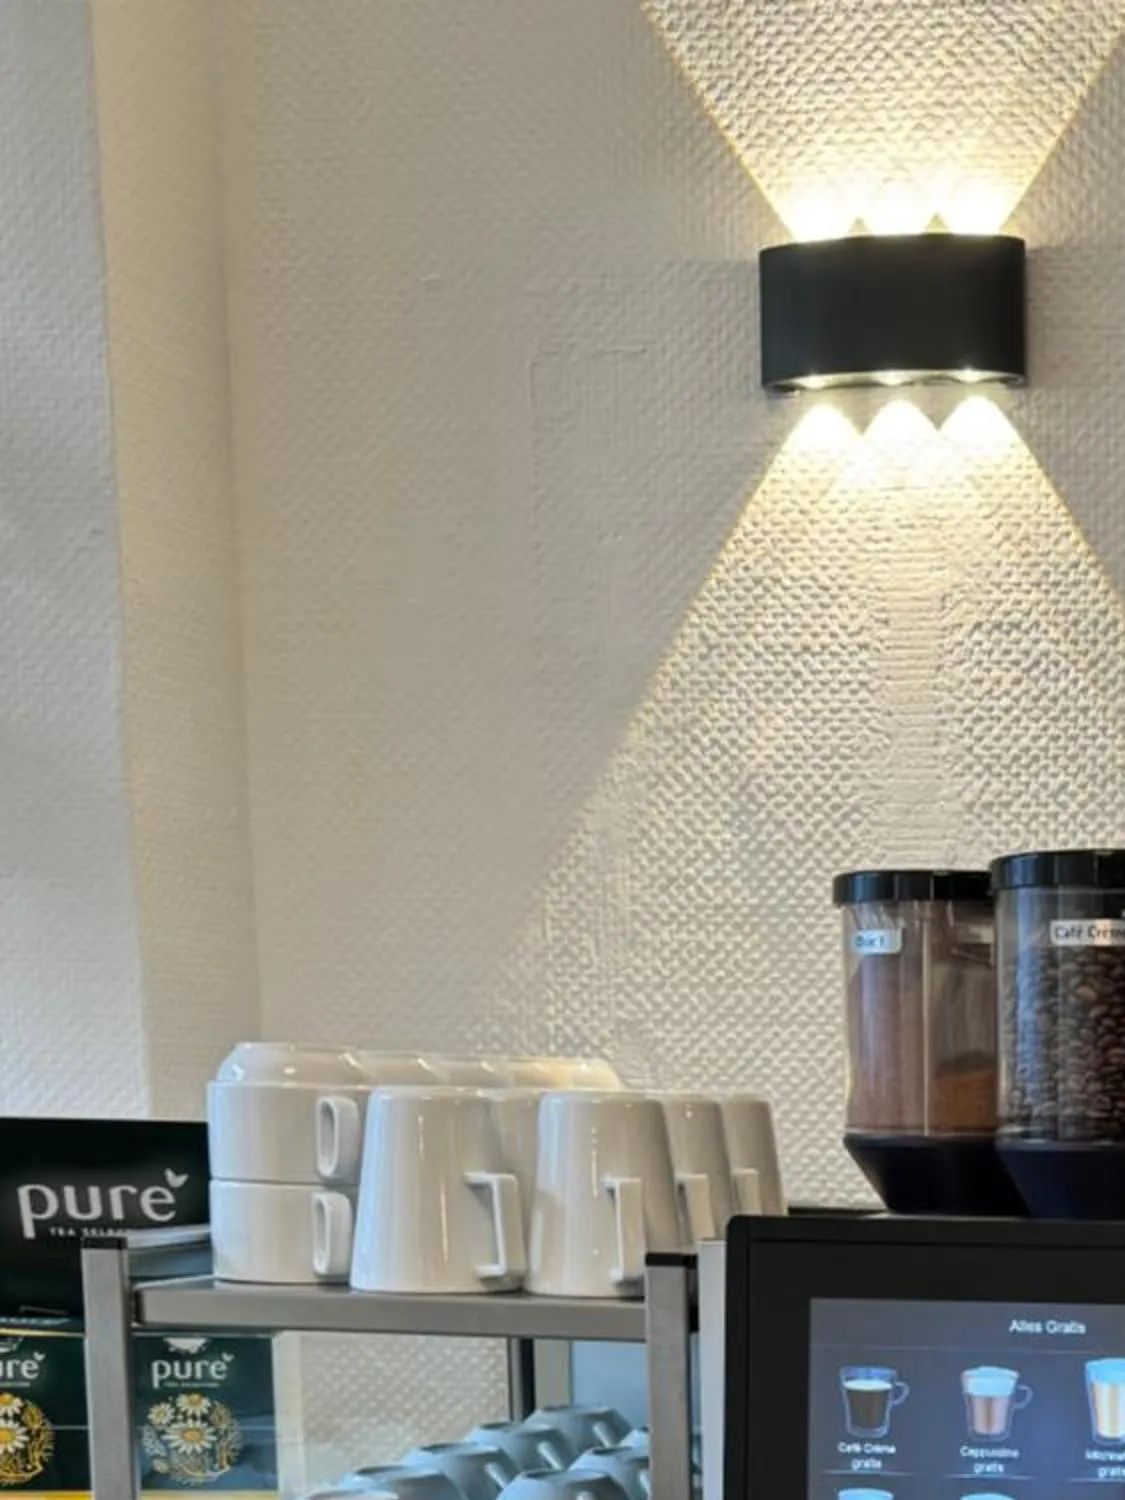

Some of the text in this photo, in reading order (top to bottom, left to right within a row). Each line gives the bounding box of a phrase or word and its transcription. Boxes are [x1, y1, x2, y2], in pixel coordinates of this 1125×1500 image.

[1054, 924, 1082, 938] Café
[17, 1183, 177, 1239] pure
[1009, 1319, 1087, 1334] Alles Gratis
[0, 1360, 40, 1379] re
[152, 1359, 229, 1389] pure
[851, 1458, 882, 1471] gratis
[973, 1462, 1004, 1474] gratis
